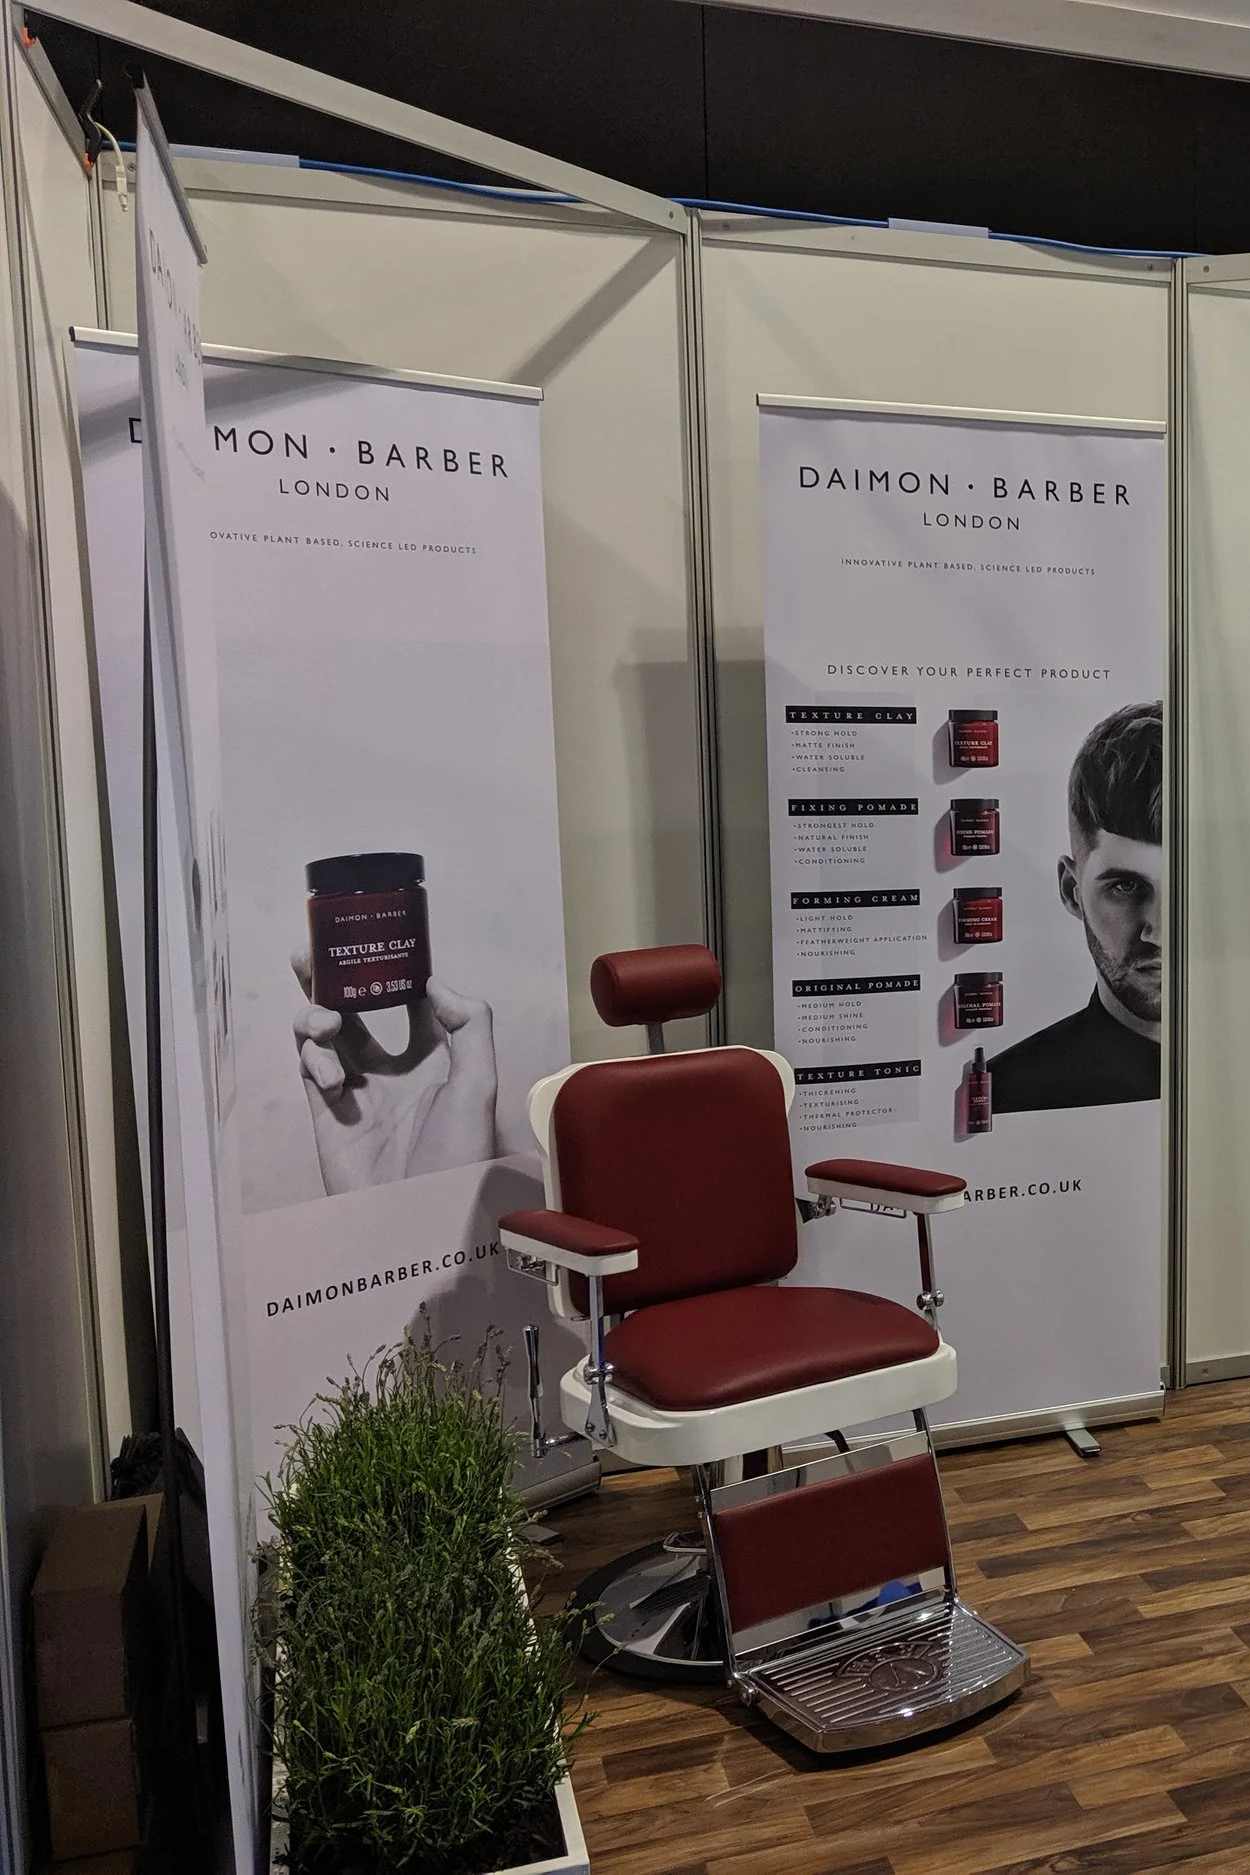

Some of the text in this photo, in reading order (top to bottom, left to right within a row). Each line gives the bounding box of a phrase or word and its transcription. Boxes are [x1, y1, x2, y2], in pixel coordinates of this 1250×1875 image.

[358, 440, 509, 479] BARBER
[279, 478, 390, 502] LONDON
[799, 466, 1131, 505] DAIMON BARBER
[923, 512, 1021, 531] LONDON
[209, 531, 258, 543] OVATIVE
[263, 534, 300, 545] PLANT
[347, 539, 393, 551] SCIENCE
[398, 542, 417, 552] LED
[421, 543, 477, 555] PRODUCTS
[841, 558, 903, 568] INNOVATIVE
[907, 560, 939, 570] PLANT
[980, 564, 1021, 573] SCIENCE
[1025, 566, 1043, 574] LED
[1047, 566, 1096, 576] PRODUCTS
[827, 664, 1111, 680] DISCOVER YOUR PERFECT PRODUCT
[789, 711, 914, 721] TEXTURE CLAY
[791, 803, 917, 812] FIXING POMADE
[792, 894, 919, 905] FORMING CREAM
[335, 910, 406, 923] DAIMON BARBER
[328, 938, 416, 958] TEXTURE CLAY
[794, 980, 919, 993] ORIGINAL POMADE
[797, 1065, 920, 1081] TEXTURE TONIC
[266, 1241, 499, 1317] DAIMONBARBER.CO.UK
